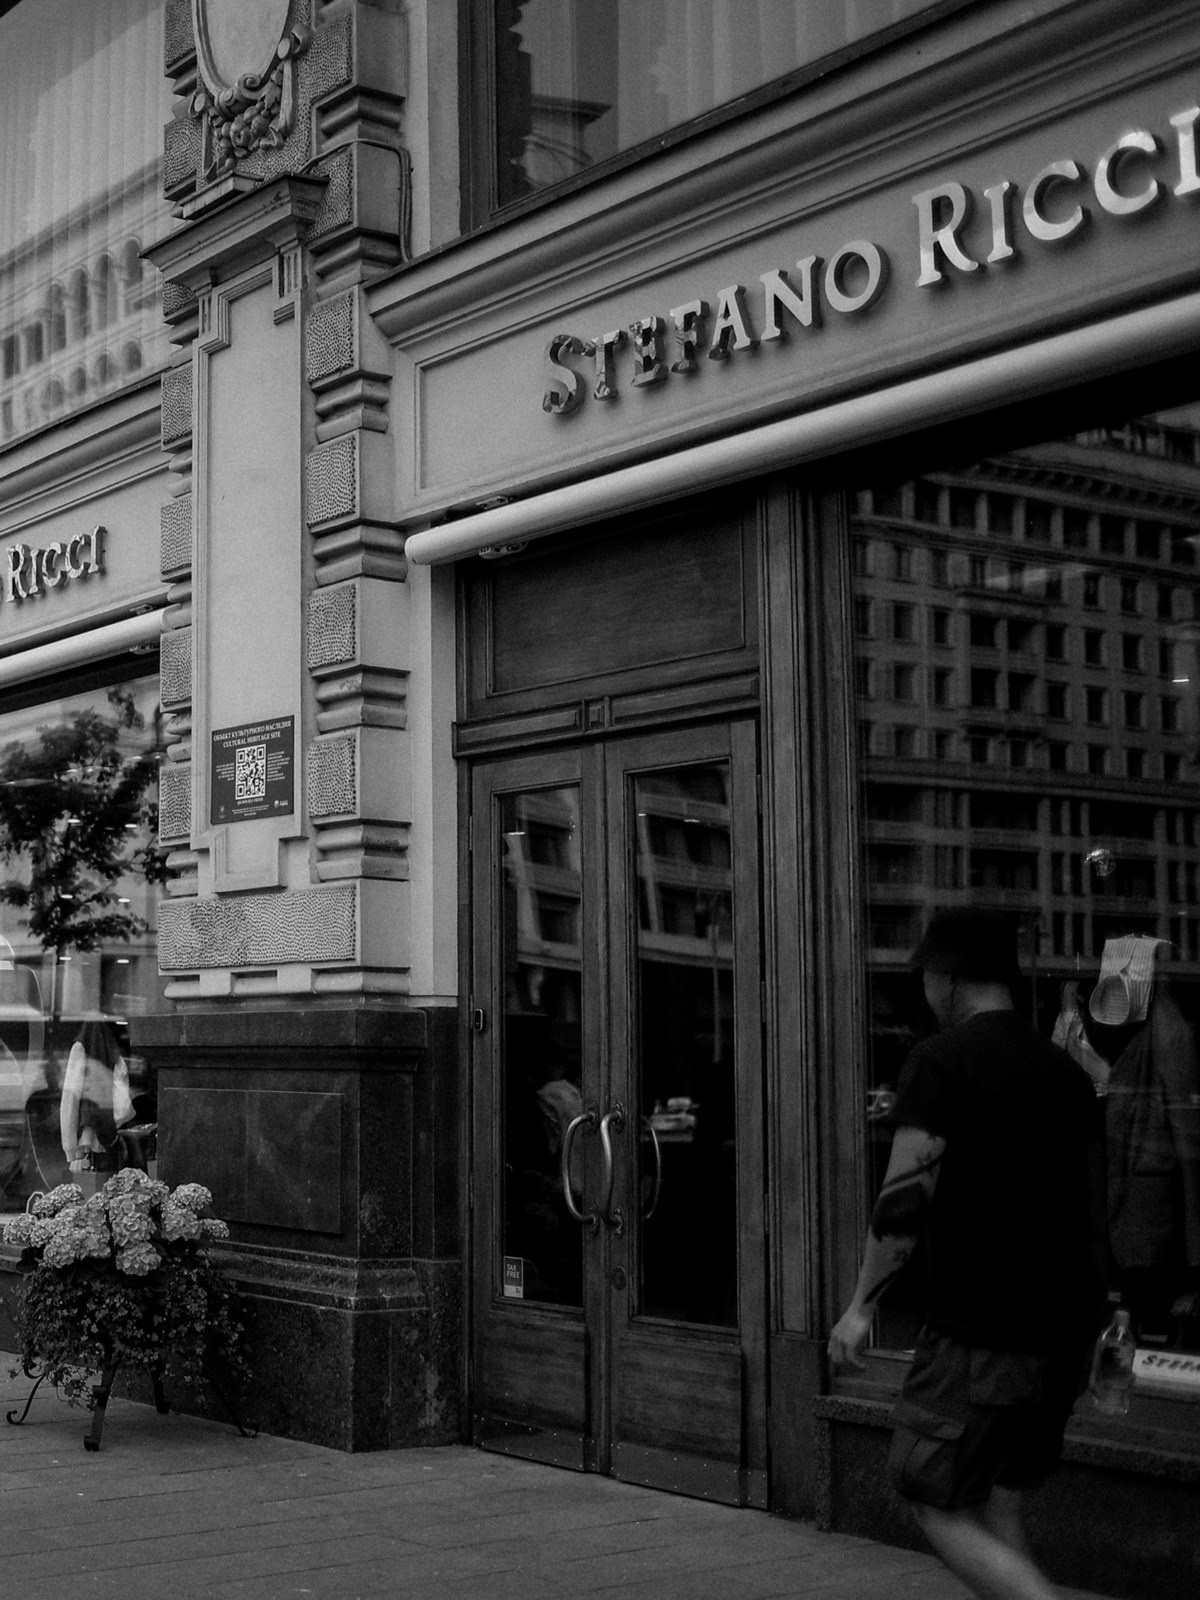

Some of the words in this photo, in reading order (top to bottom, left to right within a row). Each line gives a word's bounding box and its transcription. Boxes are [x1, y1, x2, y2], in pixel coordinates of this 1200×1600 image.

[542, 239, 889, 416] STEFANO
[911, 105, 1200, 289] RICCI
[6, 524, 107, 603] RICCI
[270, 731, 281, 739] SITE
[506, 1270, 520, 1279] FREE
